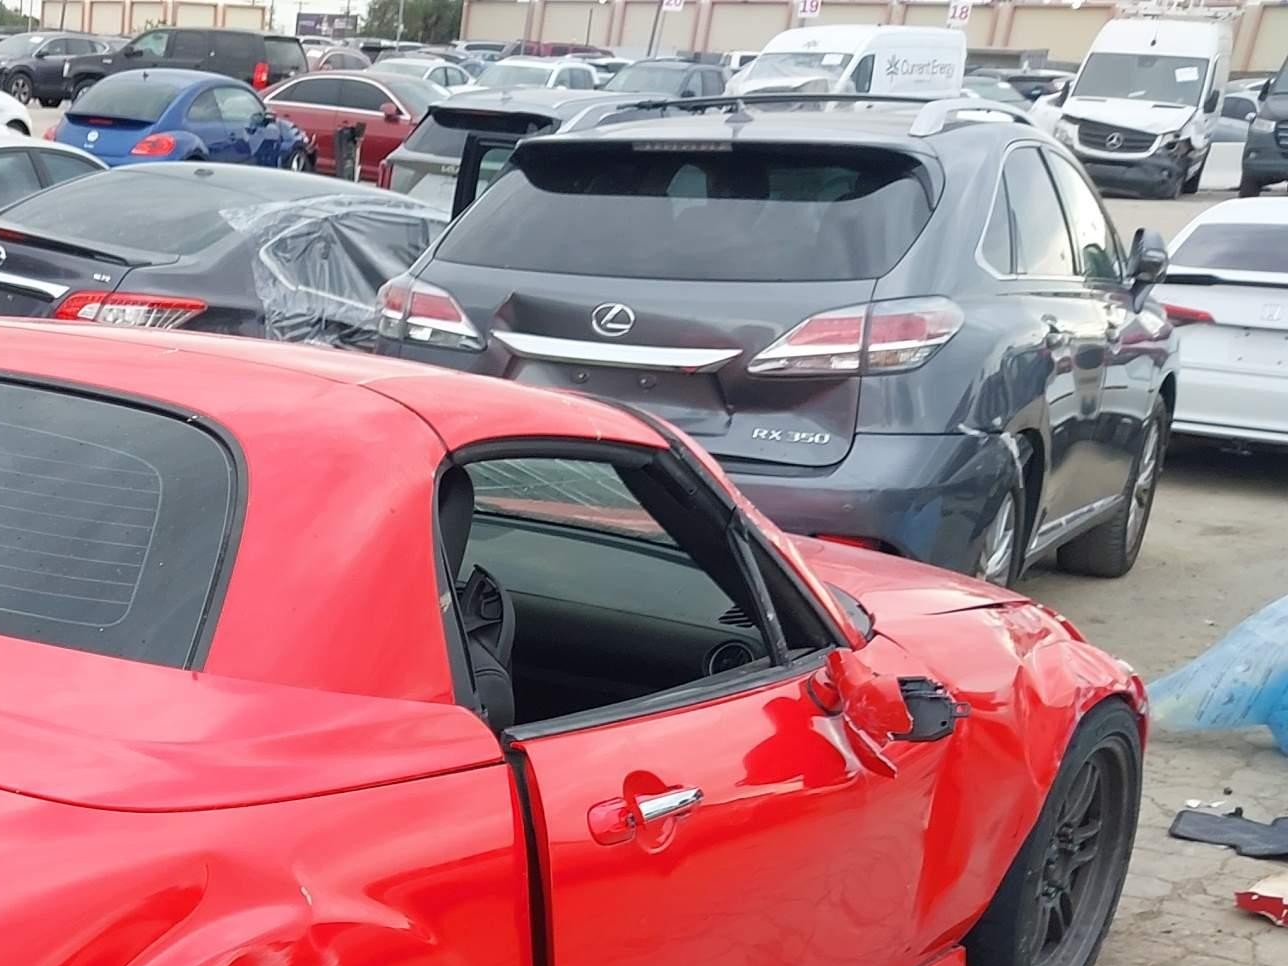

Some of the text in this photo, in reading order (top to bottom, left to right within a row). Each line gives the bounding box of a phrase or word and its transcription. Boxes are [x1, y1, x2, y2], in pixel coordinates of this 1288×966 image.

[799, 0, 819, 13] 19
[950, 5, 969, 20] 18
[751, 427, 831, 445] RX 350
